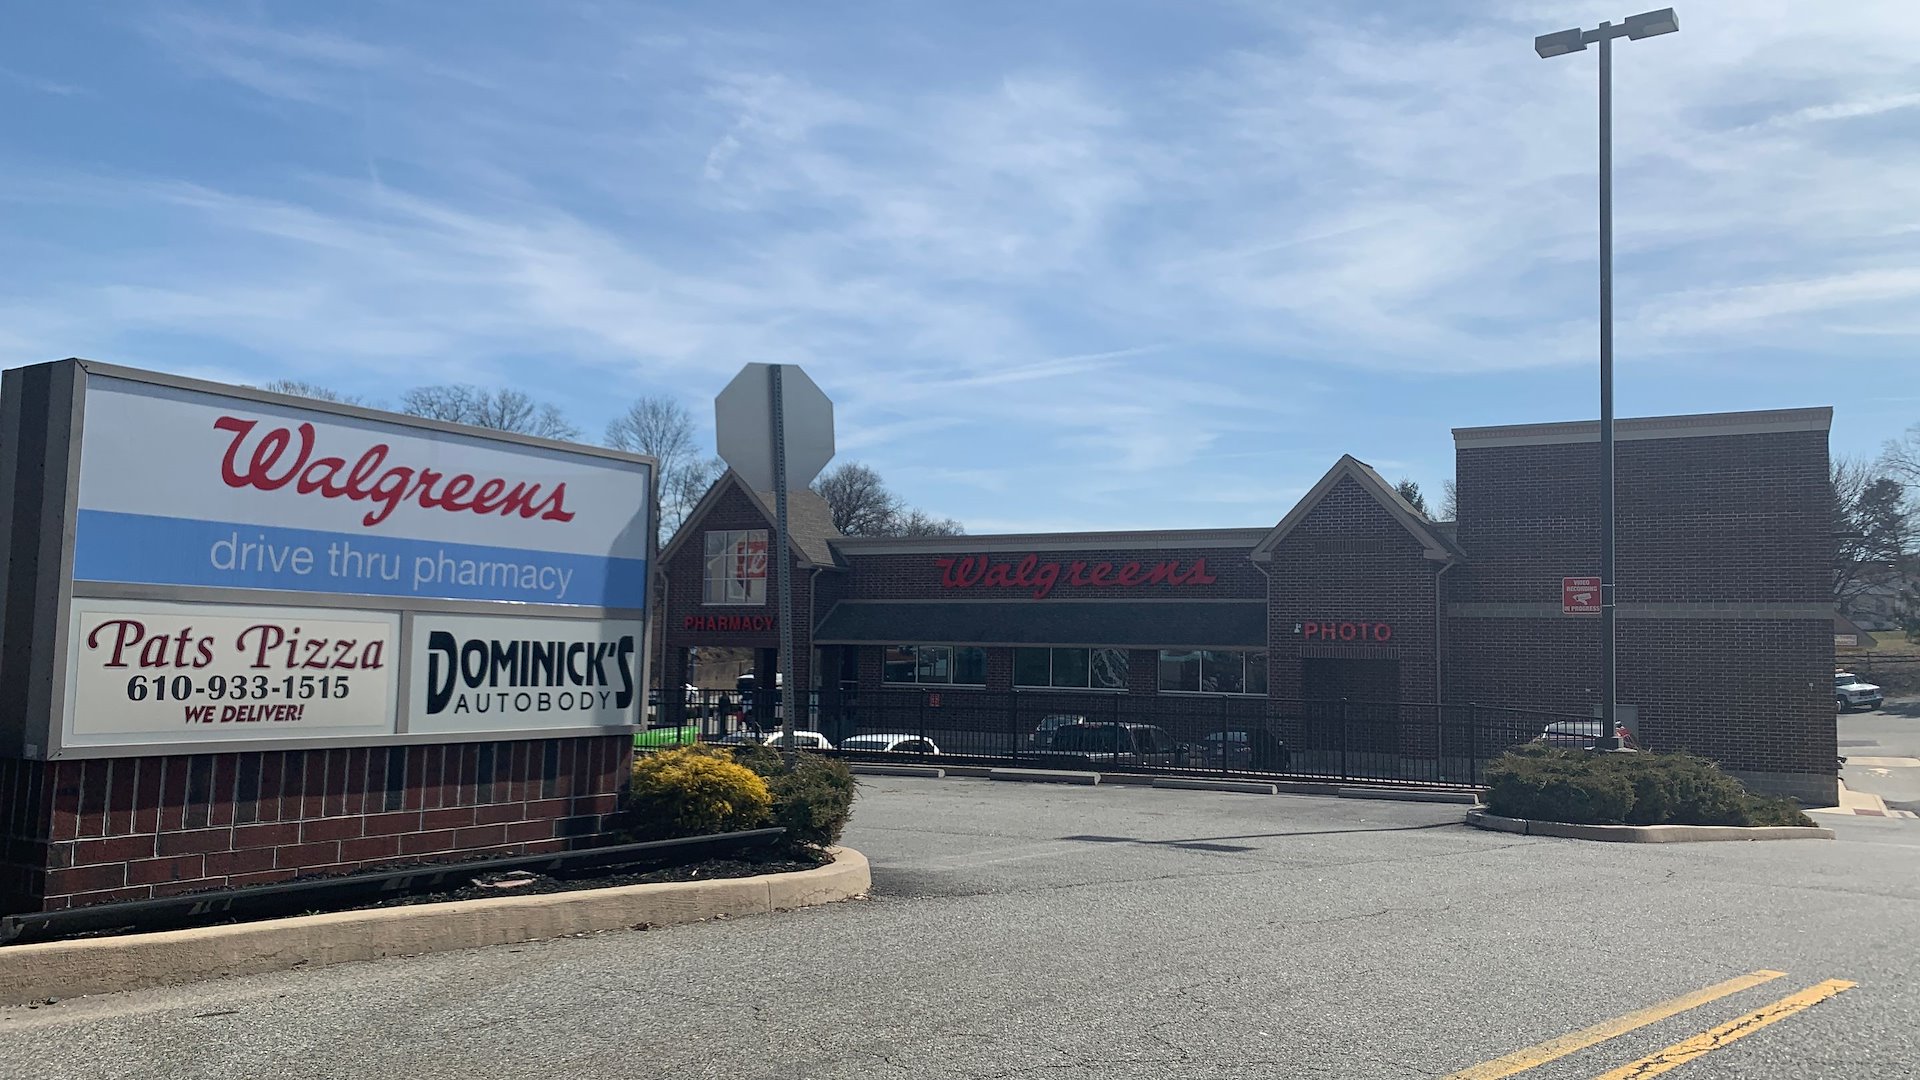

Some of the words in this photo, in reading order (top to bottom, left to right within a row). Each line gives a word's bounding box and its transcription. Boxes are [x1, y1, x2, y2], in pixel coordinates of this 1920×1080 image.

[213, 415, 576, 527] Walgreens
[210, 531, 314, 576] drive
[328, 541, 400, 580] thru
[413, 549, 574, 600] pharmacy
[935, 553, 1217, 599] Walgreens
[684, 614, 774, 631] PHARMACY
[1303, 622, 1392, 640] PHOTO
[87, 619, 215, 669] Pats
[236, 624, 384, 669] Pizza
[127, 675, 350, 701] 610-933-1515
[426, 630, 635, 715] DOMINICK'S
[184, 705, 216, 724] WE
[220, 703, 305, 722] DELIVER!
[453, 691, 611, 714] AUTOBODY
